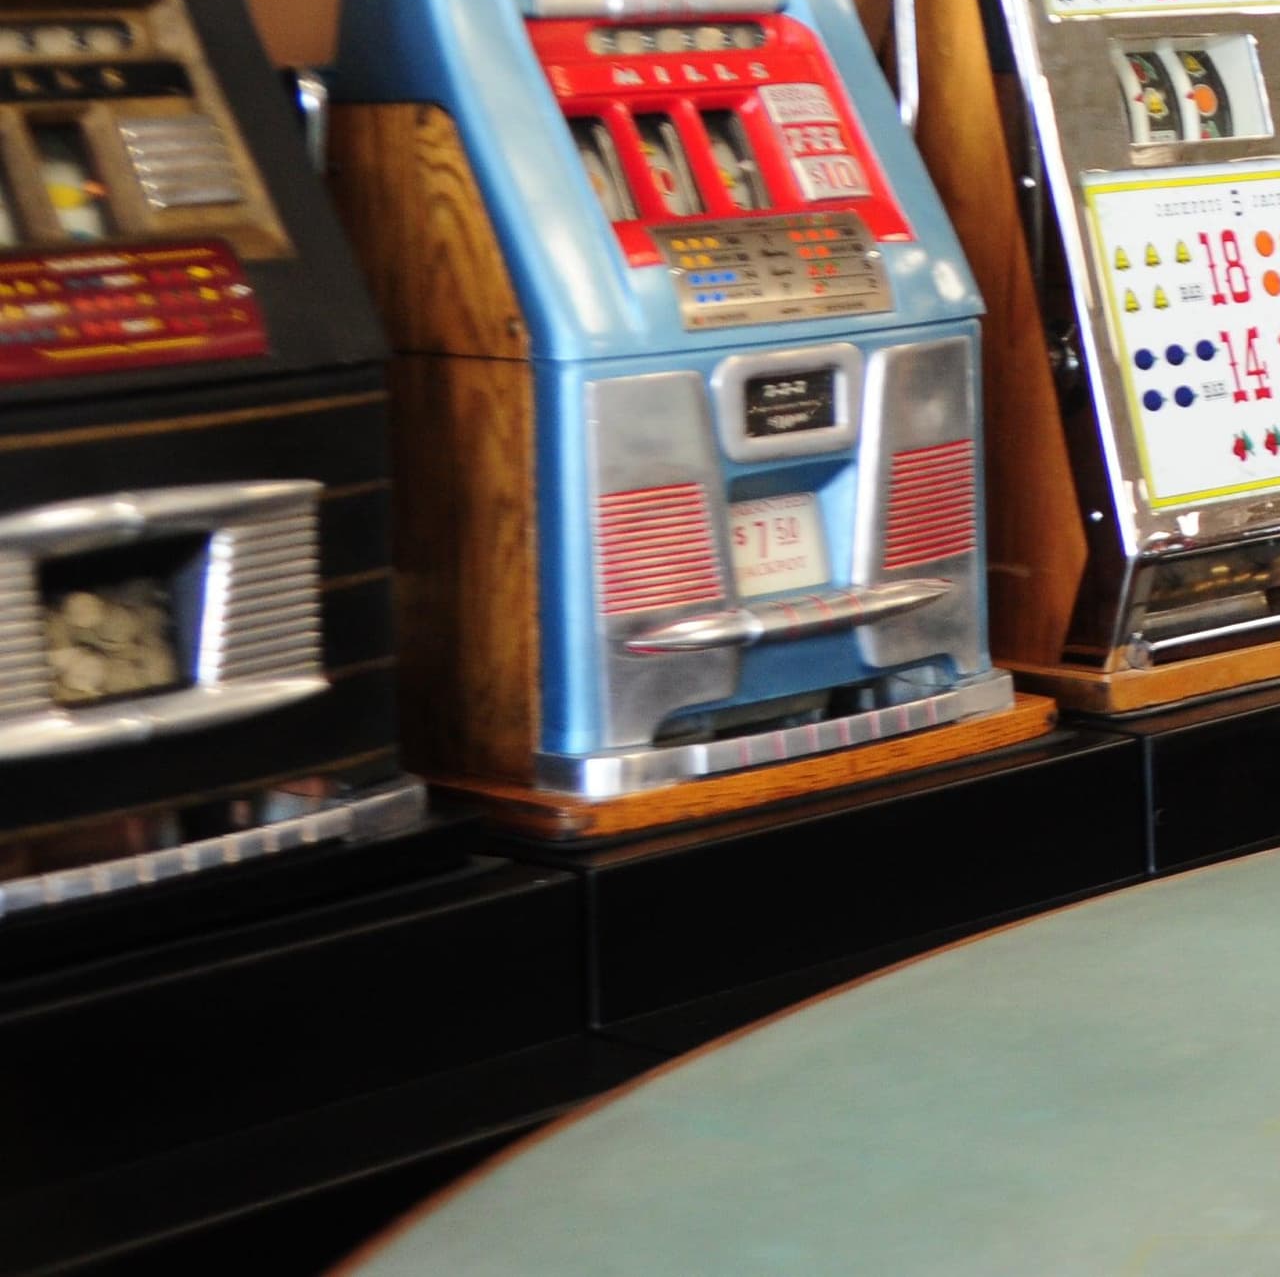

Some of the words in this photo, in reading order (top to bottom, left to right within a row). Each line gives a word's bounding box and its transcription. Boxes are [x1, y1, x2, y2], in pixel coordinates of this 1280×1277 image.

[611, 63, 770, 87] MILLS
[1197, 228, 1251, 306] 18
[1219, 326, 1273, 404] 14
